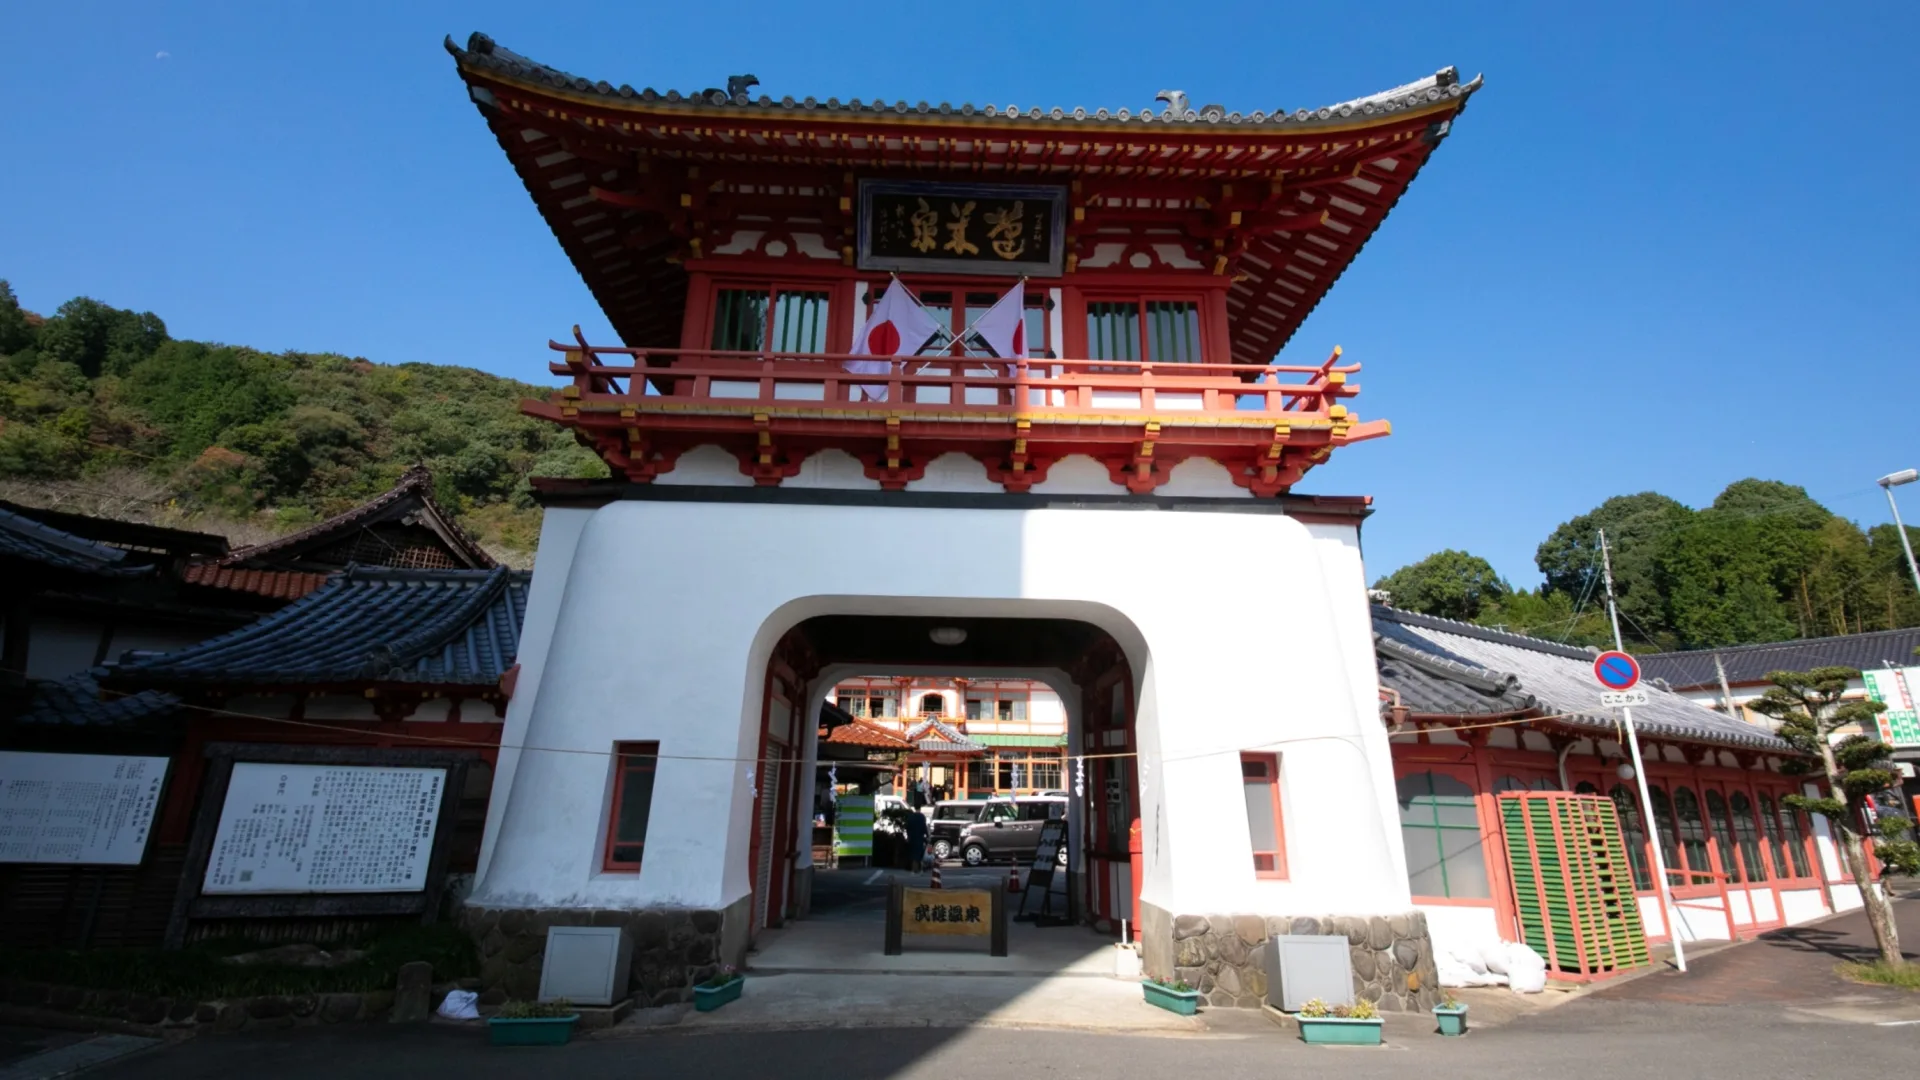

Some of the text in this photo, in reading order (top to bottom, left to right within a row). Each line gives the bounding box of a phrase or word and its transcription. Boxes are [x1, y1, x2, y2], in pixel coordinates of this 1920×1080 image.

[1603, 693, 1646, 704] ここから
[914, 903, 981, 923] 武雄温泉
